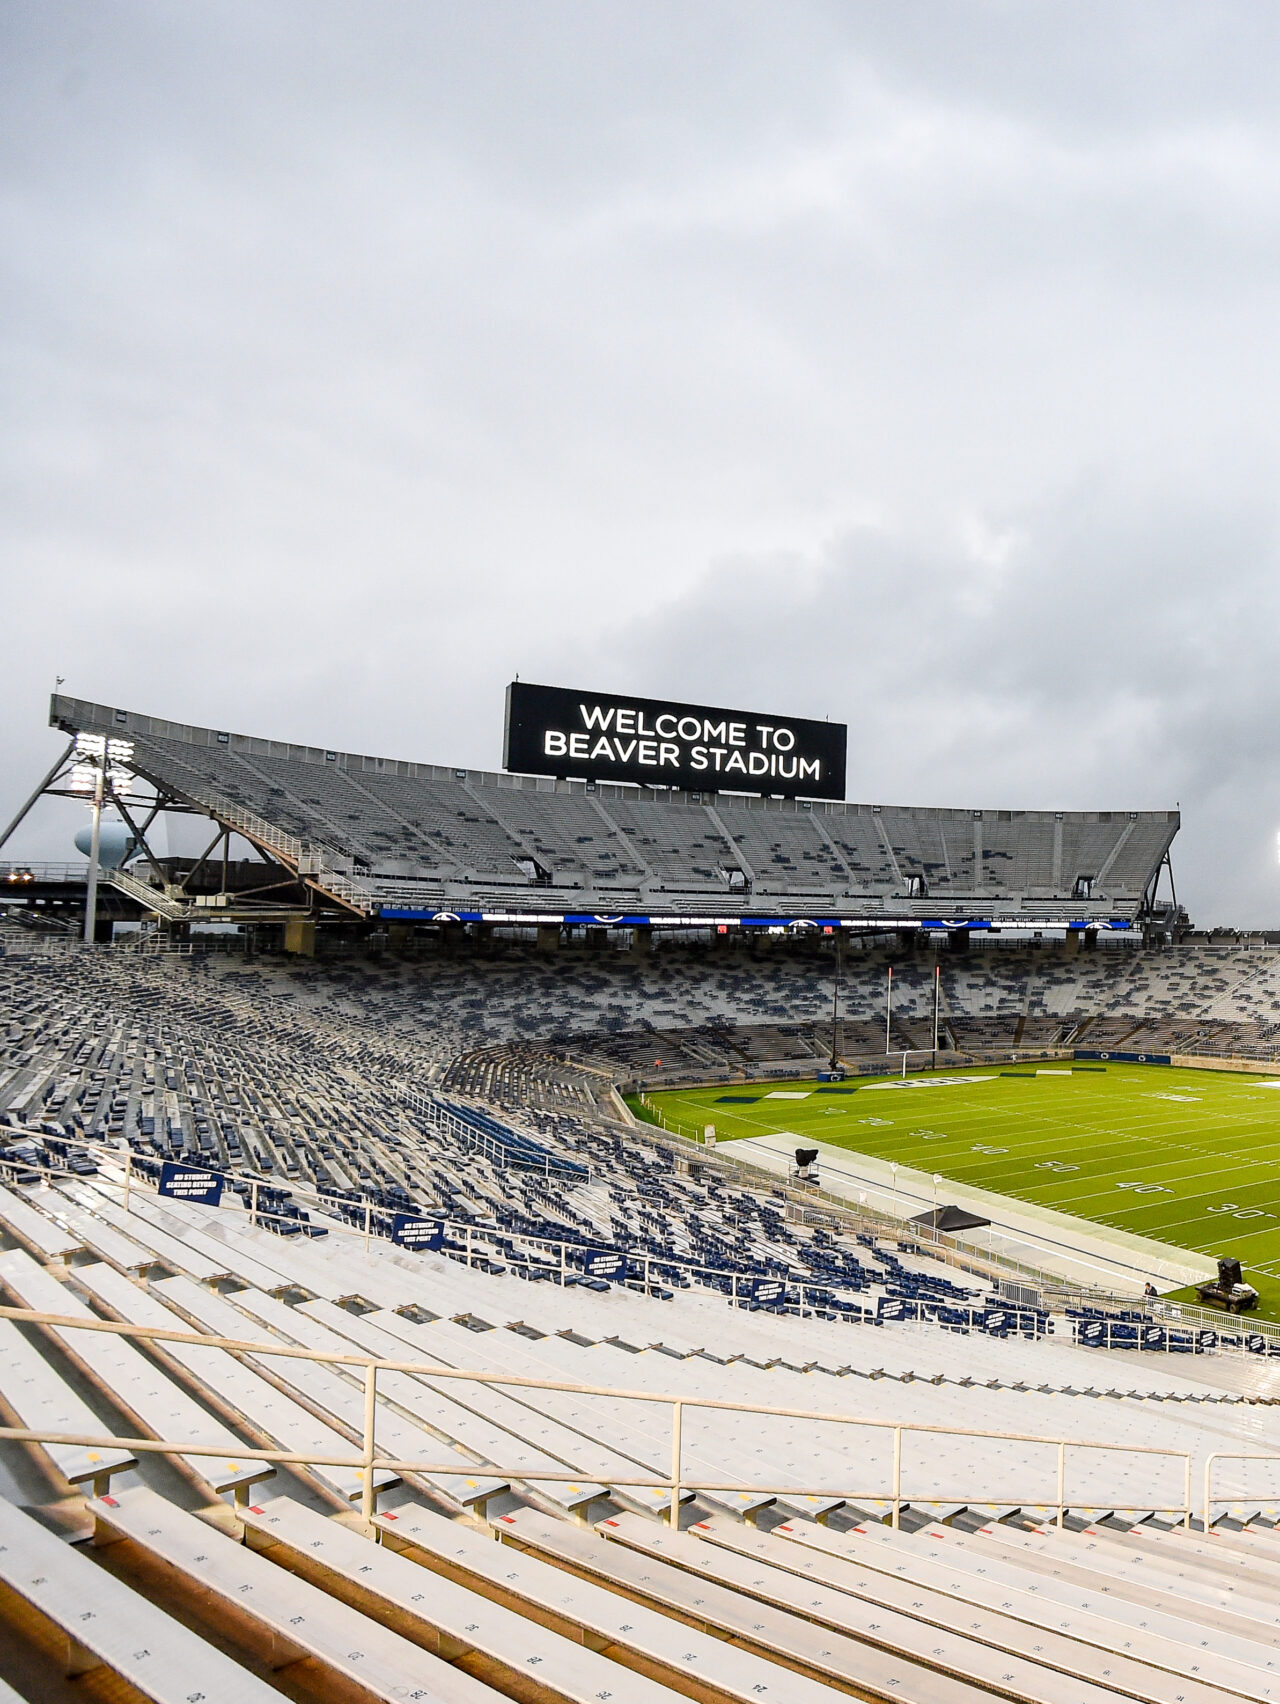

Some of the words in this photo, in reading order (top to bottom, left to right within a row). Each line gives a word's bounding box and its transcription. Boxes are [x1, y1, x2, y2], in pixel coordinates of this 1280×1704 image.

[579, 703, 748, 747] WELCOME
[756, 725, 795, 752] TO
[543, 730, 680, 768] BEAVER
[690, 746, 821, 781] STADIUM
[1034, 1160, 1081, 1173] 50
[1115, 1181, 1164, 1194] 40
[1207, 1203, 1265, 1219] 30
